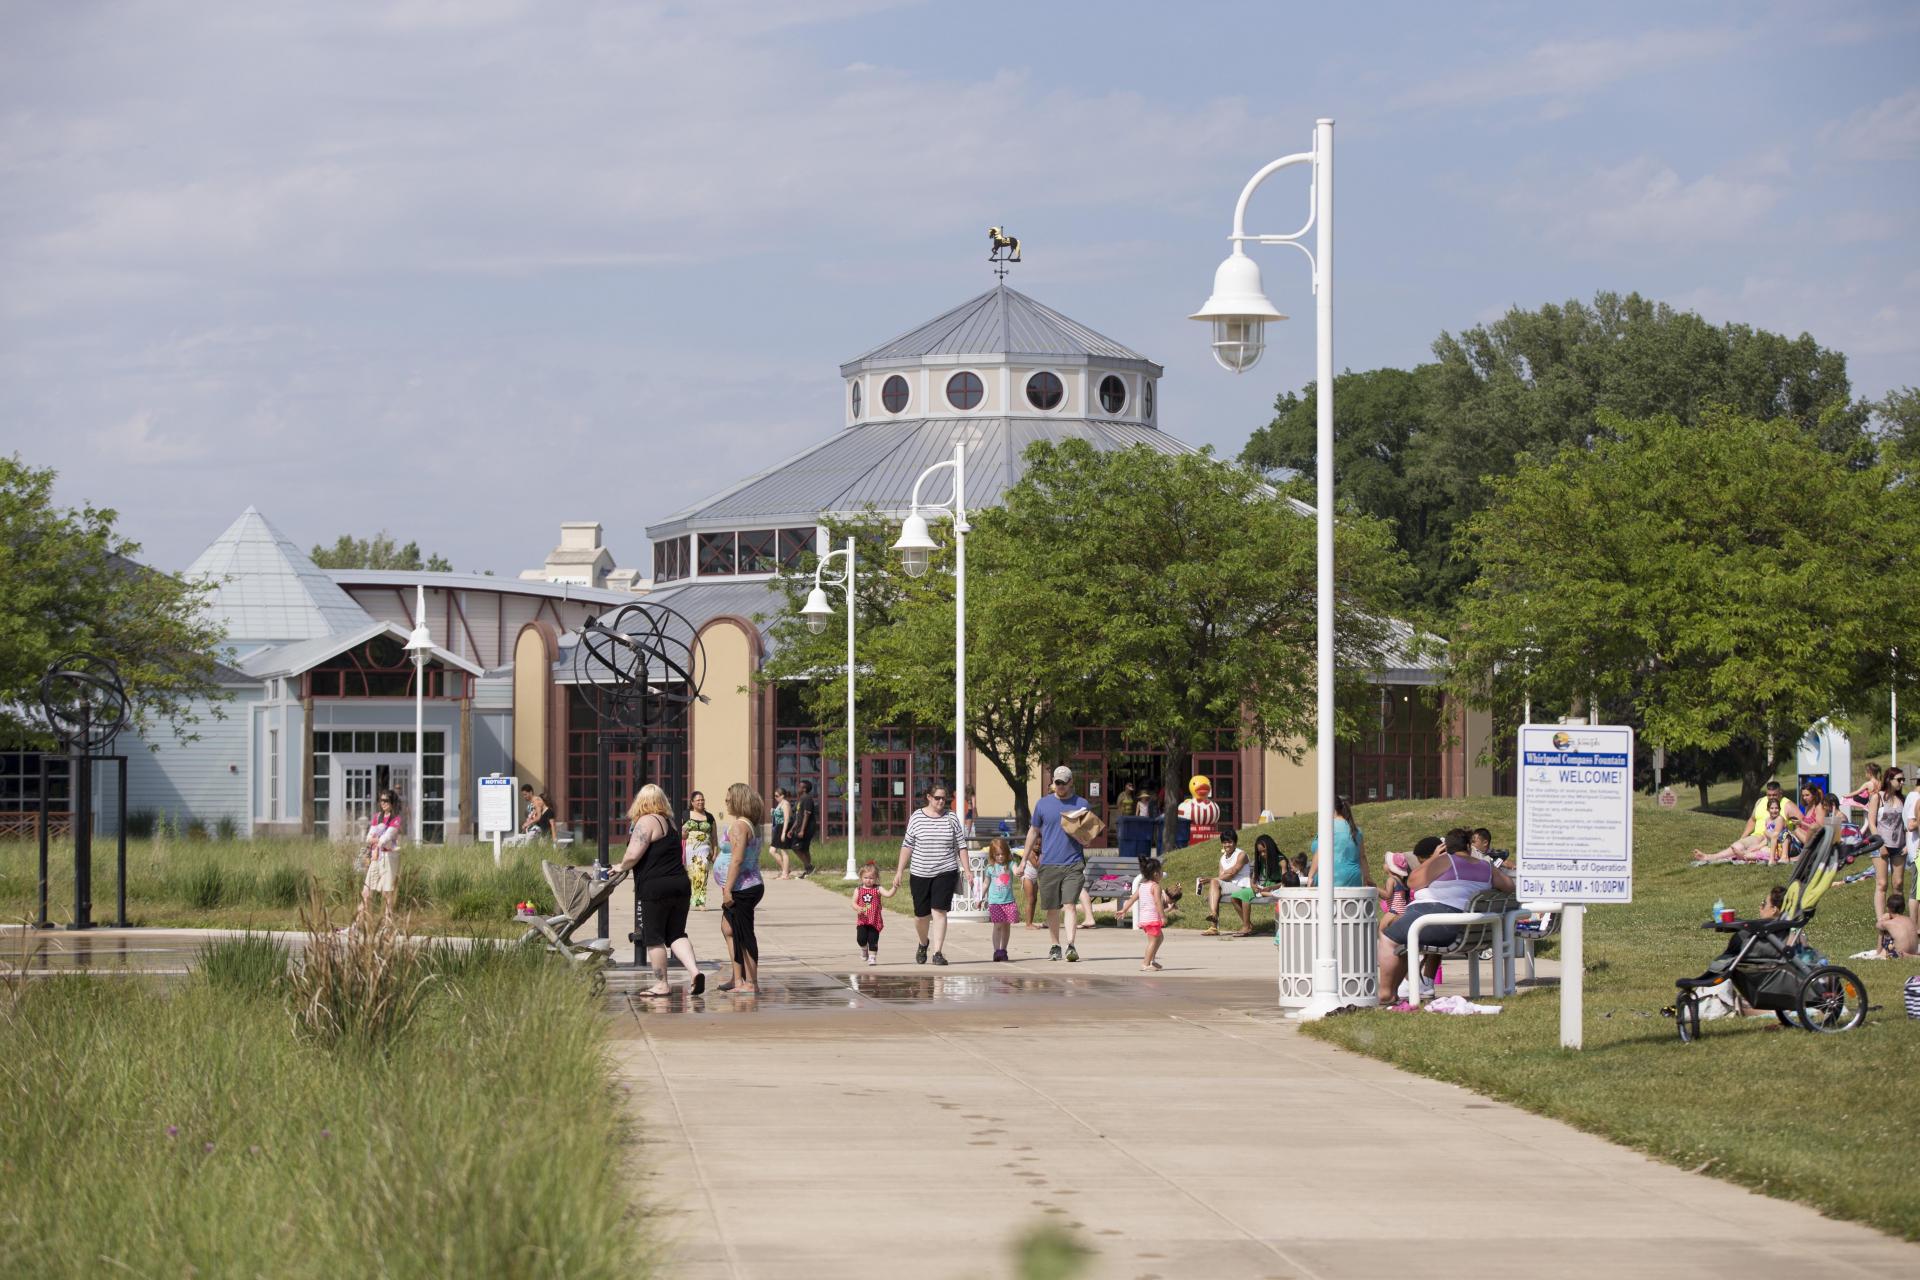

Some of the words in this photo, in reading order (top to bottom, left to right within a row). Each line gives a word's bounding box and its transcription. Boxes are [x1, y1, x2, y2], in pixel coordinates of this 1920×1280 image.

[1526, 752, 1561, 767] Whirlpool
[1562, 753, 1593, 767] Compass
[1594, 754, 1625, 765] Fountain
[1558, 769, 1622, 784] WELCOME!
[1522, 862, 1555, 871] Fountain
[1556, 862, 1580, 871] Hours
[1581, 863, 1589, 871] of
[1590, 863, 1627, 873] Operation
[1550, 880, 1582, 893] 9:00AM
[1590, 880, 1625, 893] 10:00PM
